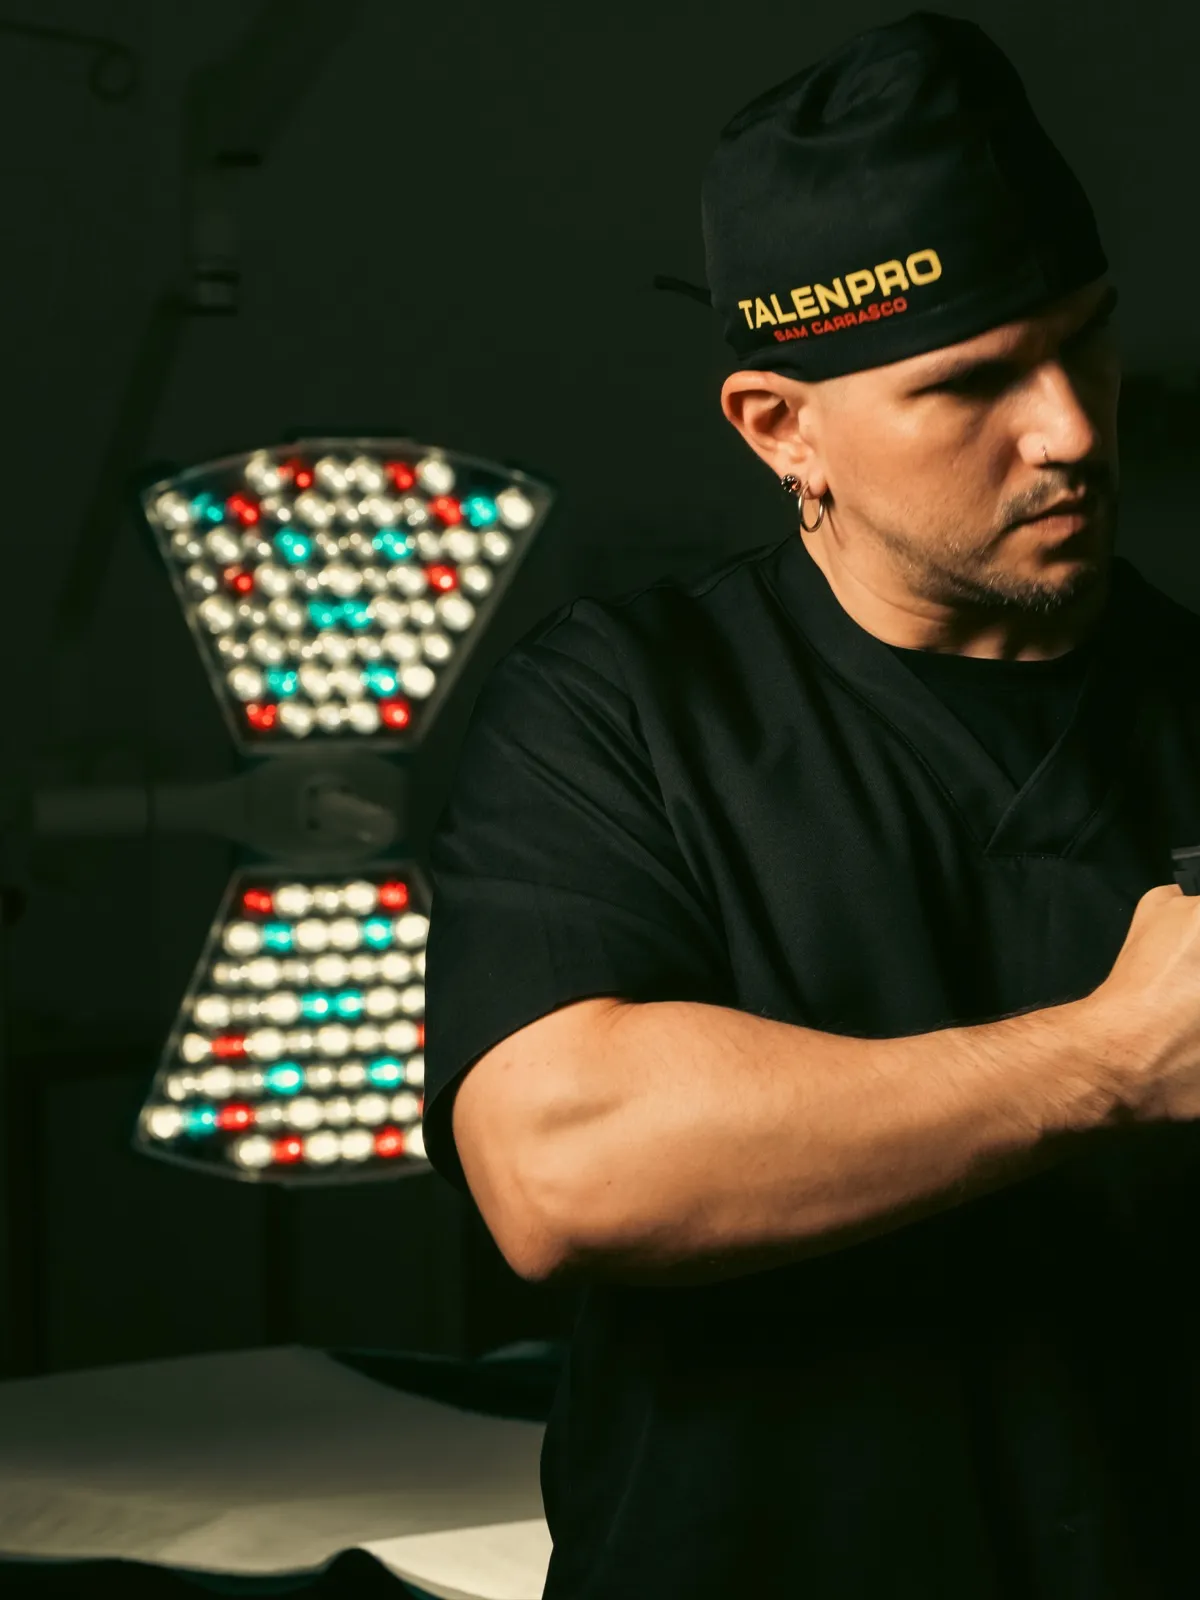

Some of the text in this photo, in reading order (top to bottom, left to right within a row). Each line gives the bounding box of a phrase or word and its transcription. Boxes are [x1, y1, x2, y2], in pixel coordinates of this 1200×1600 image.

[738, 249, 942, 330] TALENPRO
[773, 296, 908, 342] SAM CARRASCO
